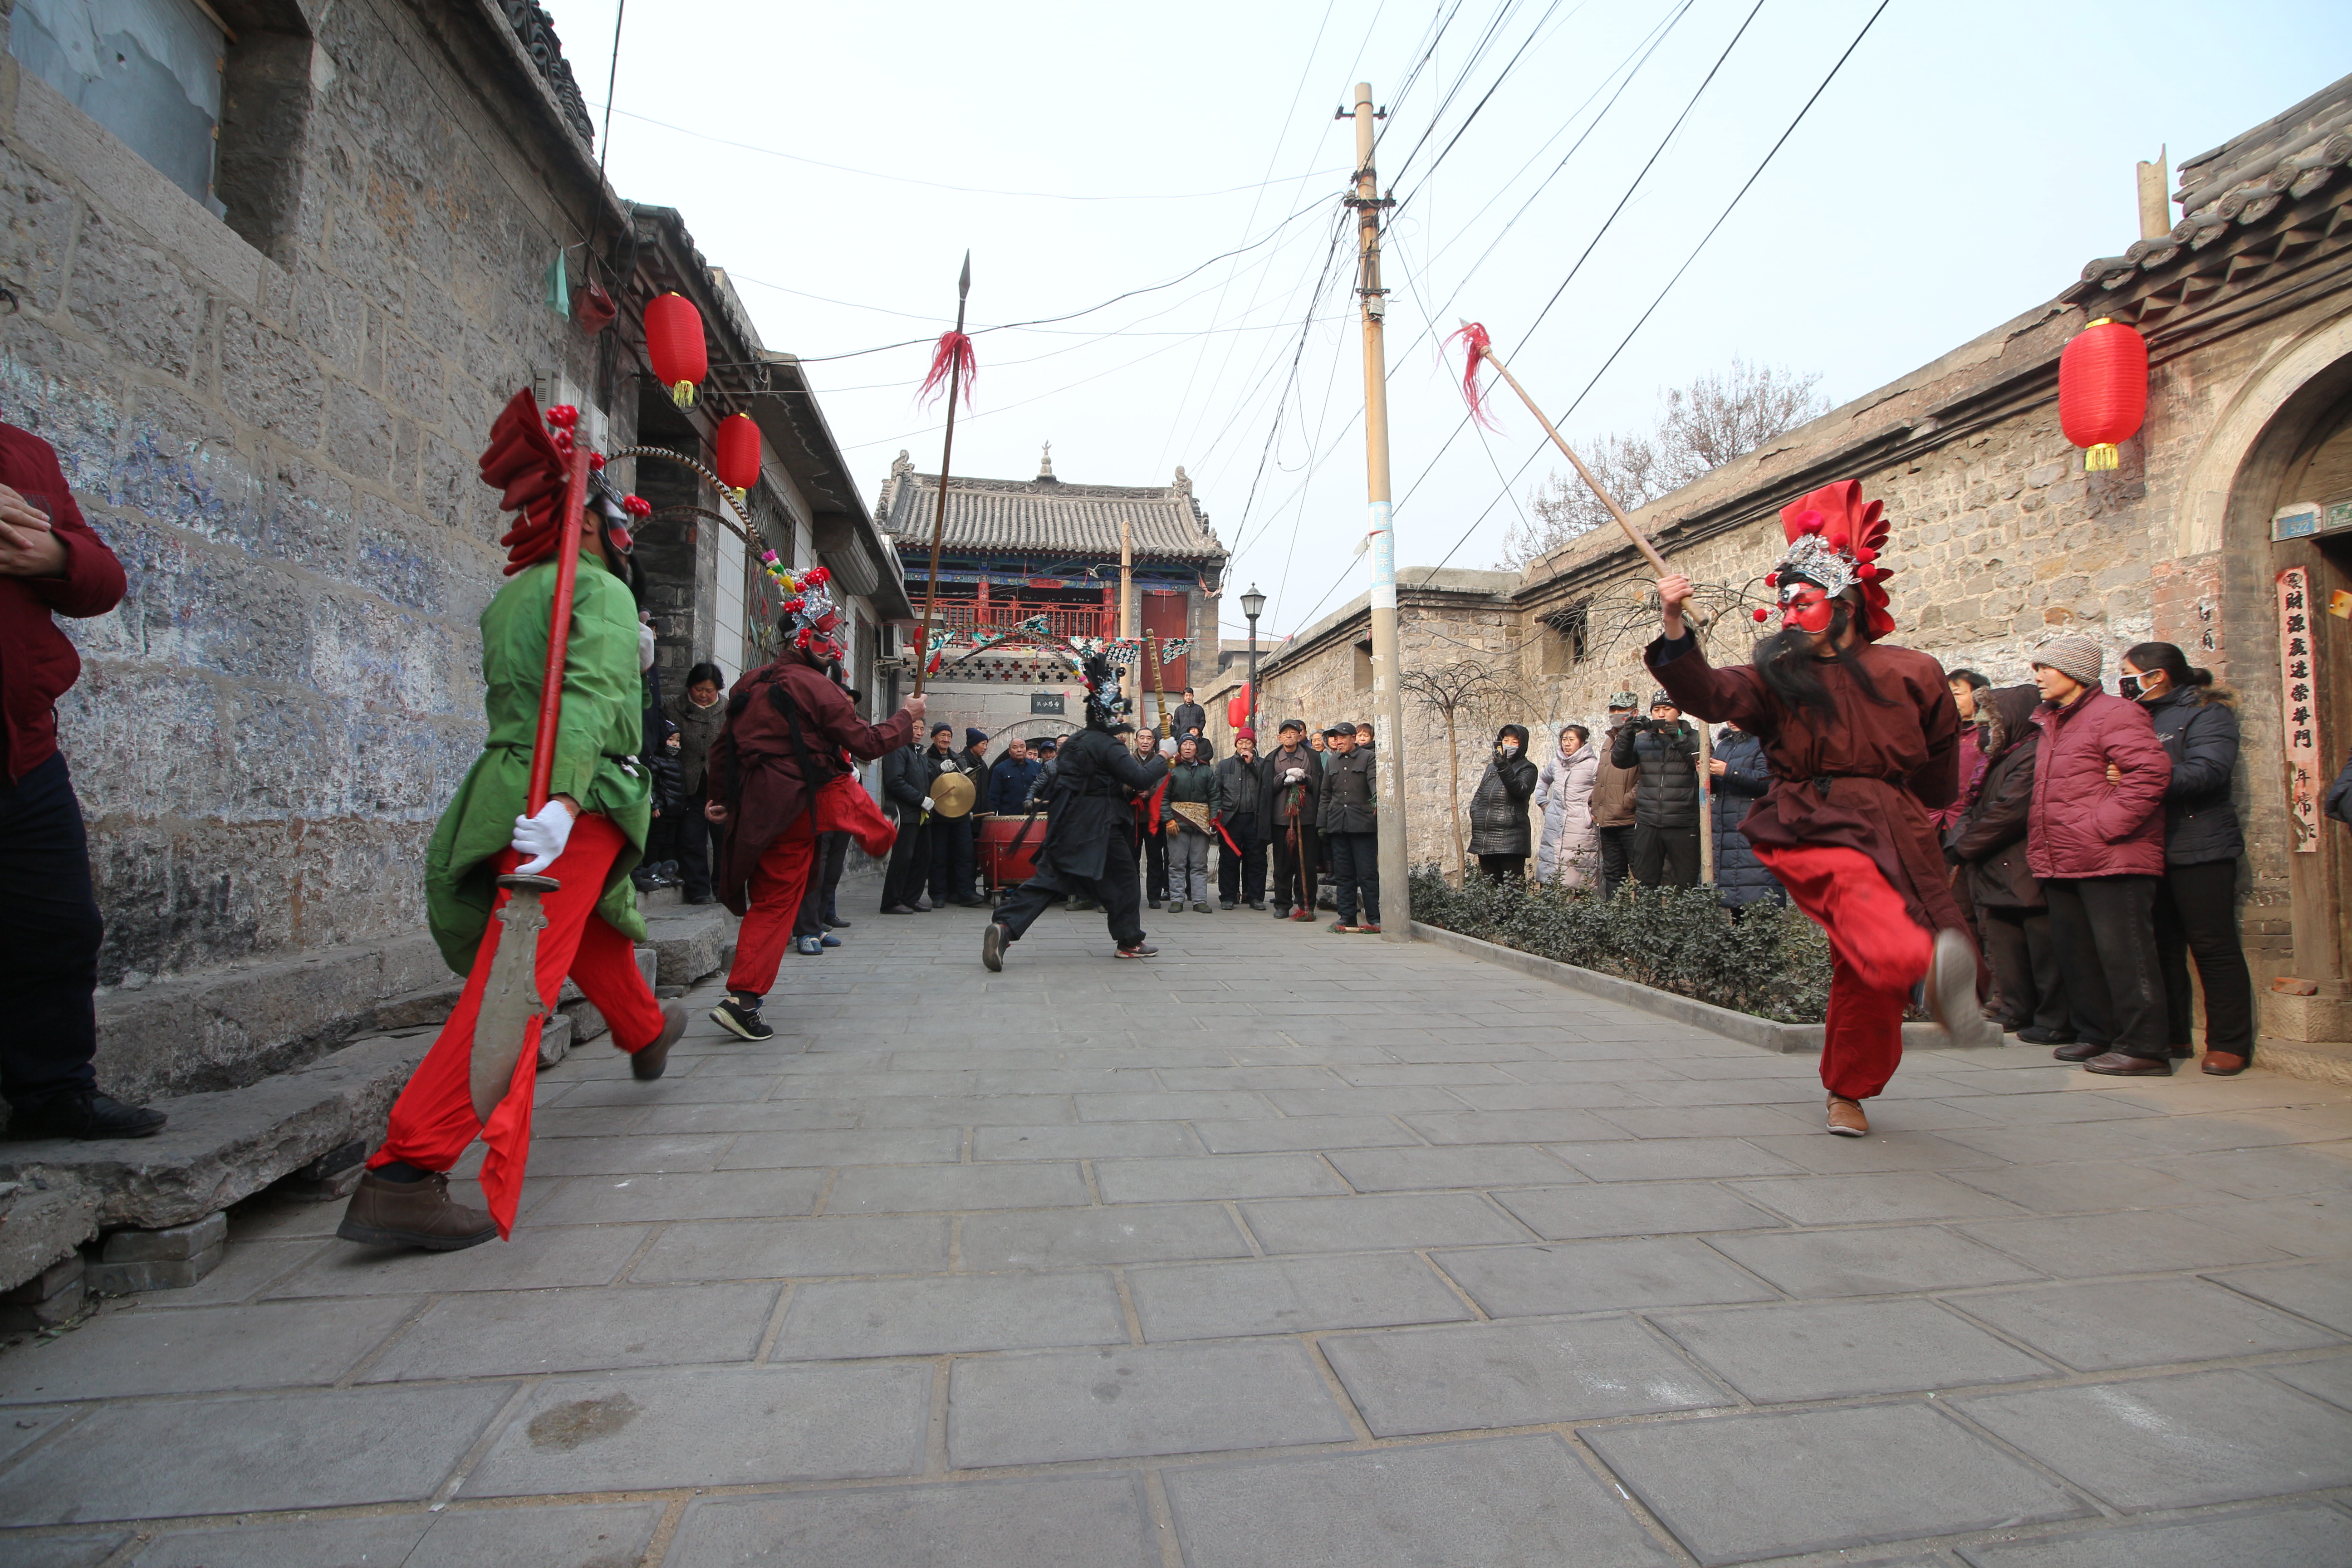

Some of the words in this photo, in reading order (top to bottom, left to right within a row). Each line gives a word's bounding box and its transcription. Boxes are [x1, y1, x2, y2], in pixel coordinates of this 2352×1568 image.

[2290, 522, 2309, 534] 522
[1378, 515, 1389, 583] 看月经不调
